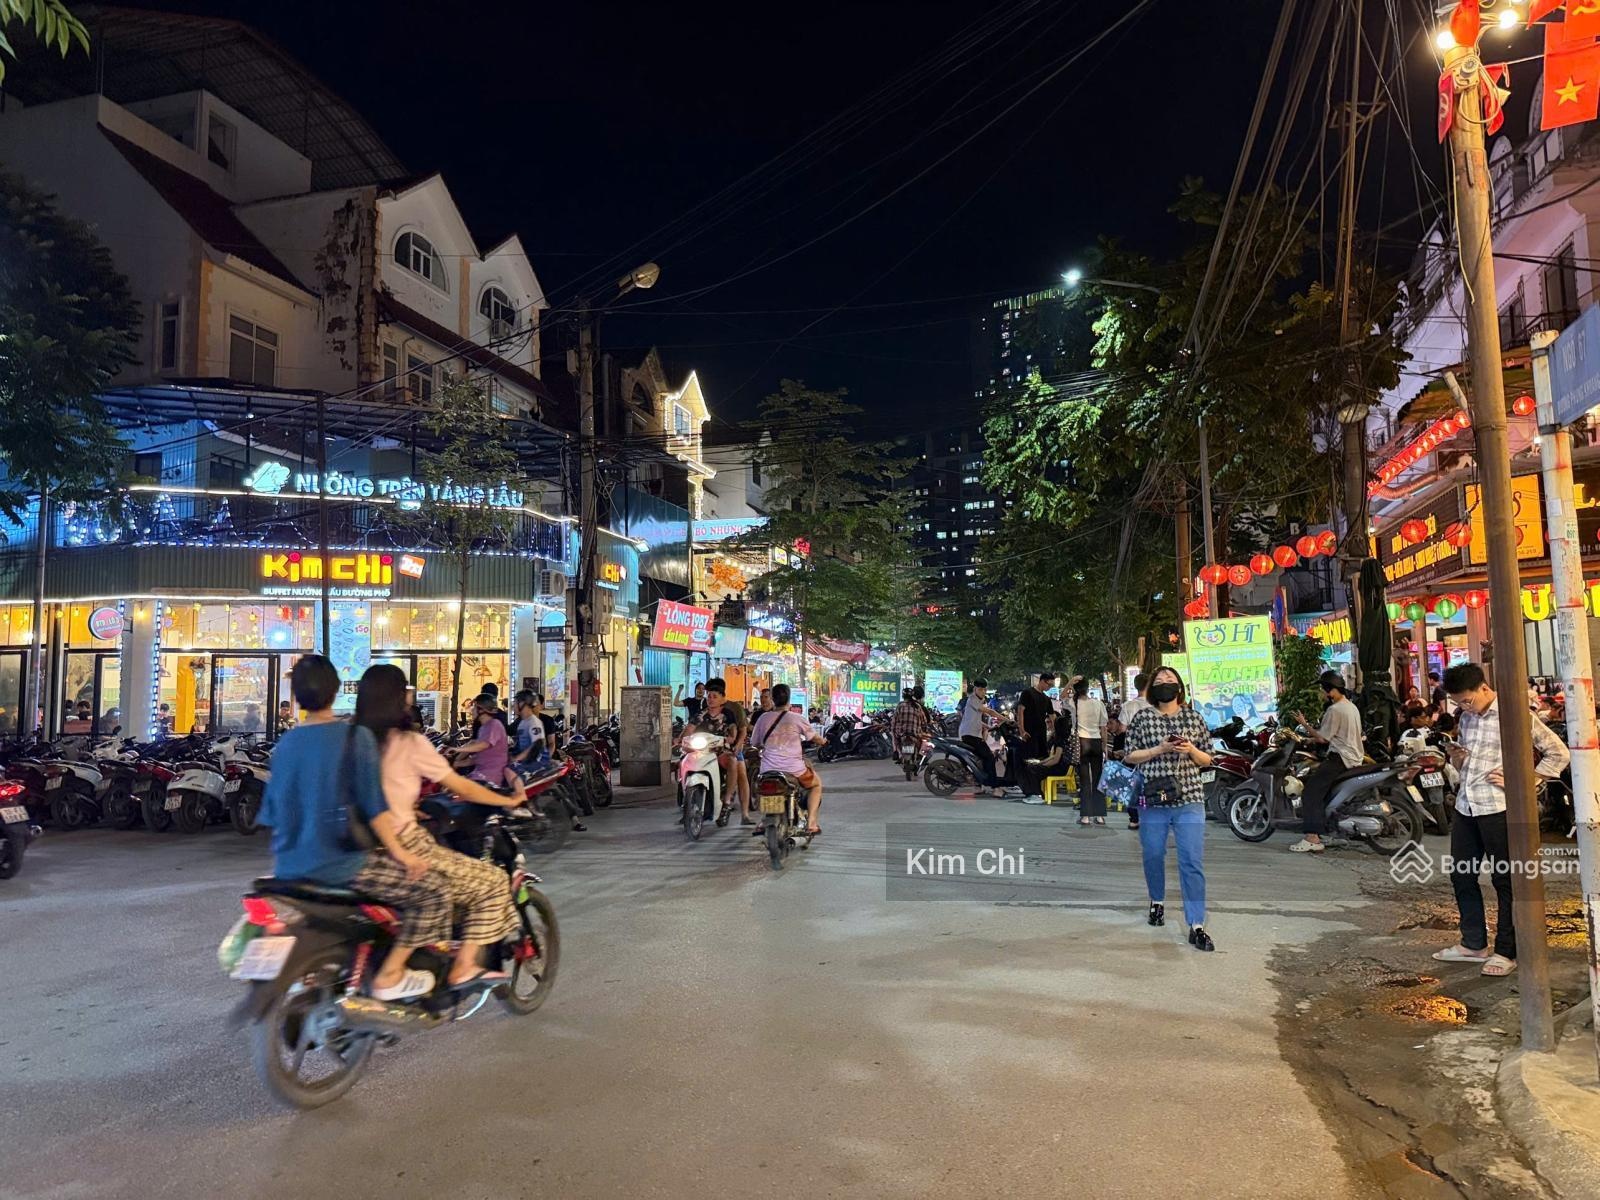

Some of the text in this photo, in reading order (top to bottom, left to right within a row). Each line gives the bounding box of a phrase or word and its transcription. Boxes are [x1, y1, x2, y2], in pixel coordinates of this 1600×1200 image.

[666, 604, 710, 629] LÒNG 1987
[832, 693, 861, 705] LÒNG
